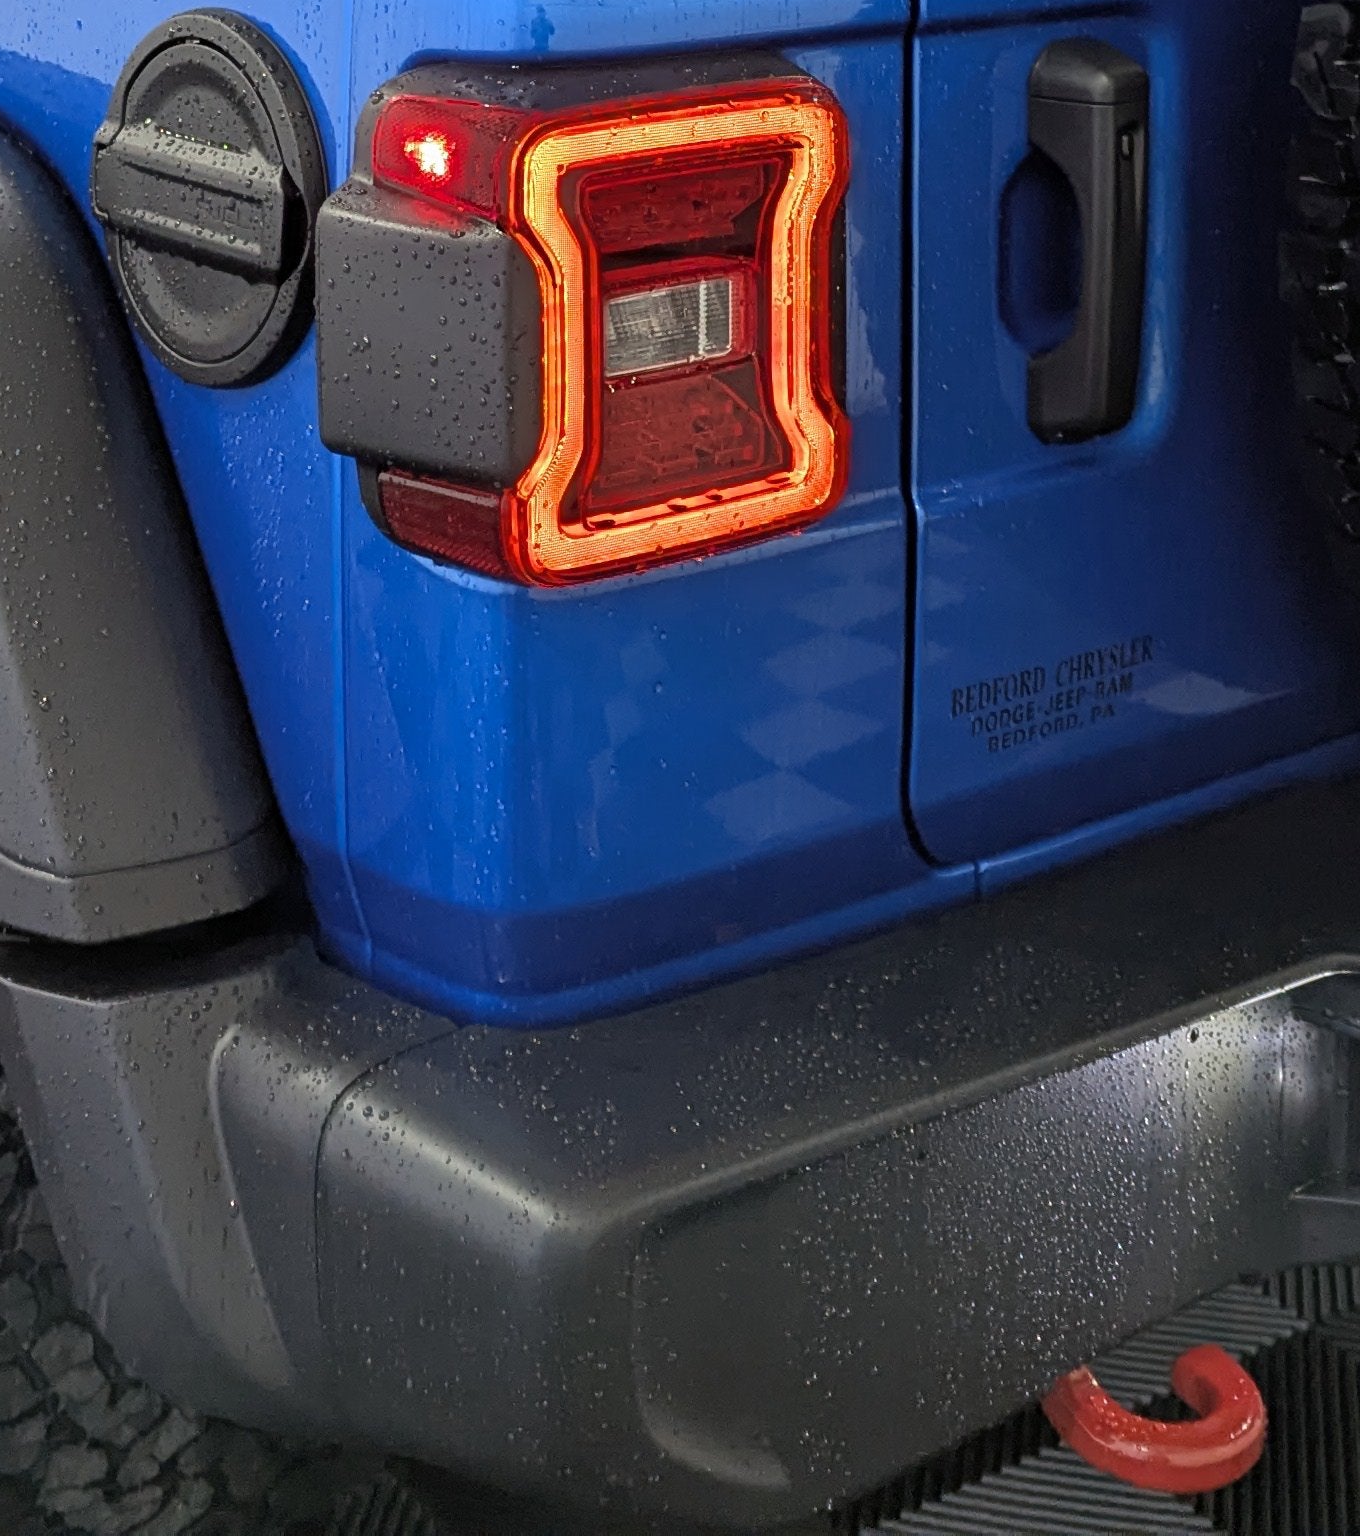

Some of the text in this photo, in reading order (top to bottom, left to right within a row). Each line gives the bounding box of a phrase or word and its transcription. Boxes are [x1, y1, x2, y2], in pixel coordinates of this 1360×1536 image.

[951, 635, 1154, 718] BEDFORD CHRYSLER
[1092, 703, 1116, 723] PA
